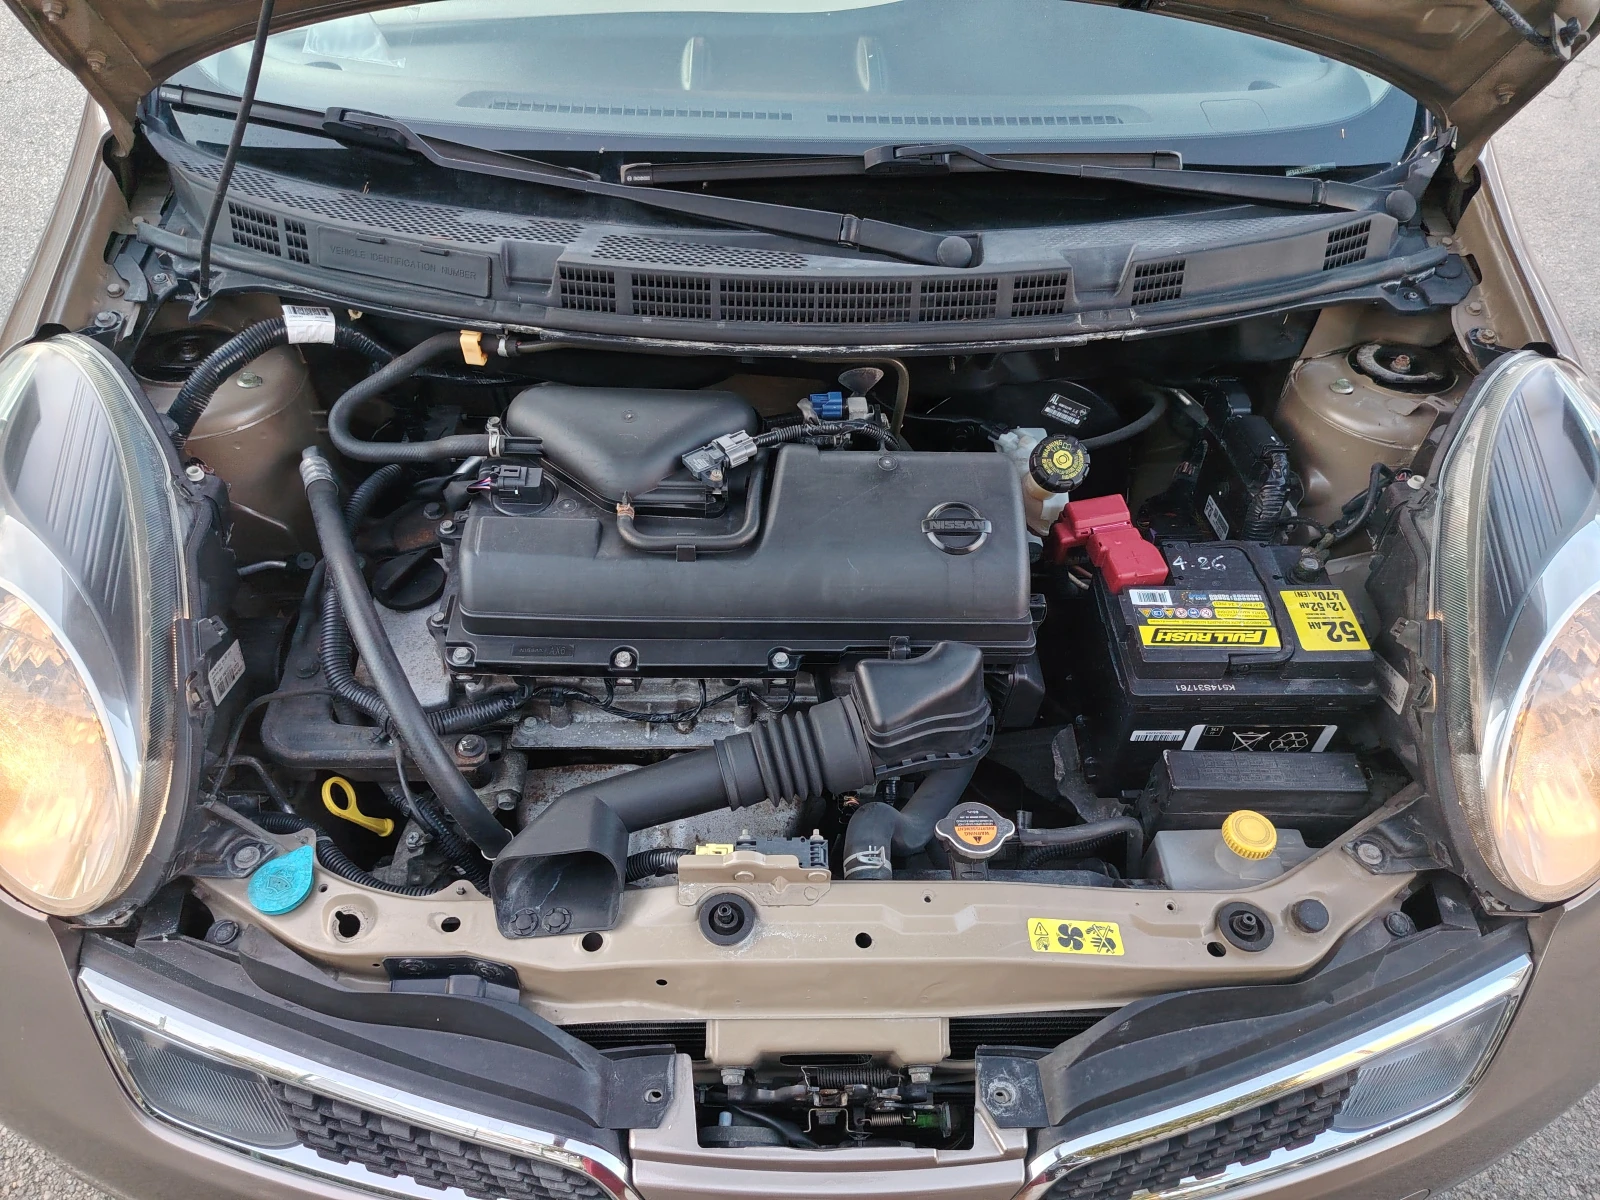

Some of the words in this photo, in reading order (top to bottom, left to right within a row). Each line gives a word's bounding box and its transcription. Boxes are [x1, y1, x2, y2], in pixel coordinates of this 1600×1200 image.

[330, 245, 367, 260] VEHICLE
[370, 252, 437, 273] IDENTIFICATION
[441, 266, 477, 280] NUMBER
[928, 519, 985, 530] NISSAN
[1155, 631, 1214, 642] RUSH
[1213, 630, 1263, 643] FULL
